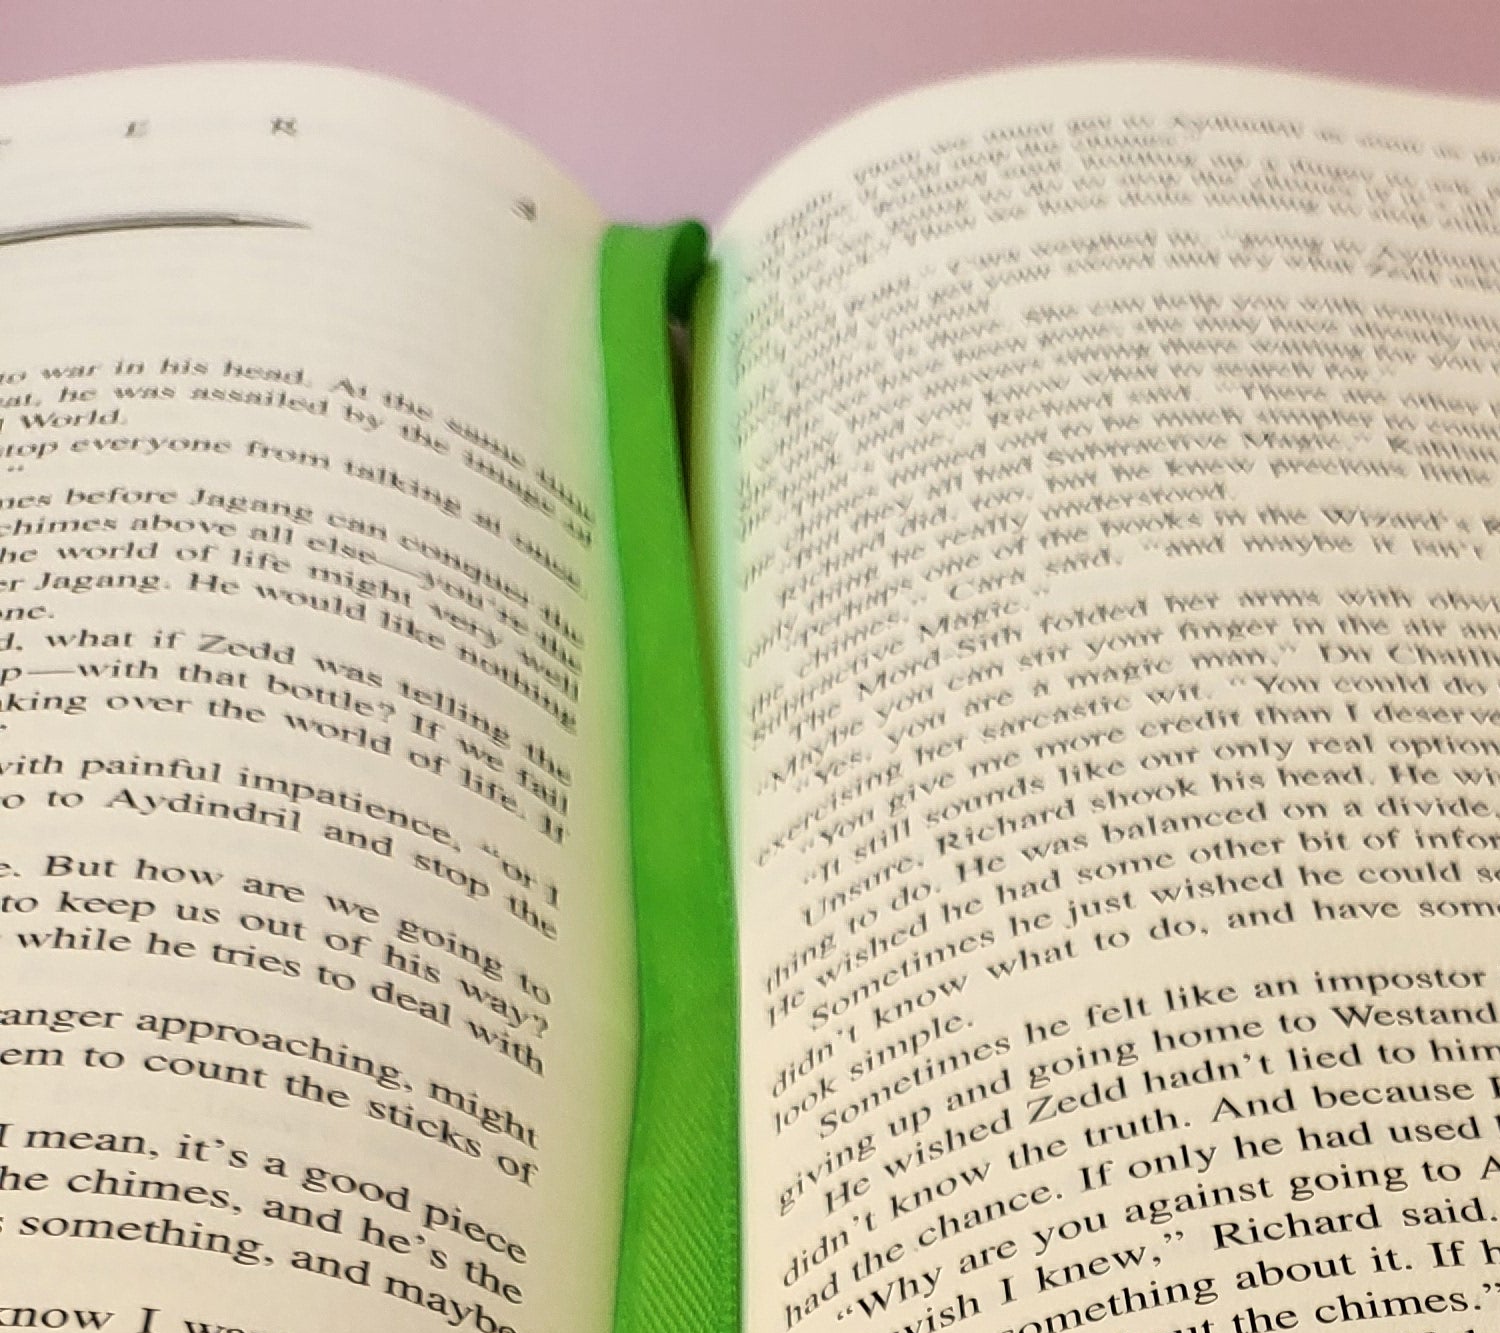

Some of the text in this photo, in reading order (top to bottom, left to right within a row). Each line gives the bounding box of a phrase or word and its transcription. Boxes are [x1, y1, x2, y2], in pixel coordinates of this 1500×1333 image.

[80, 755, 221, 783] painful
[239, 767, 461, 853] impatience,
[545, 880, 559, 910] I
[44, 855, 551, 1006] But how are we going to
[84, 1047, 125, 1069] to
[143, 1055, 268, 1089] count
[285, 1074, 350, 1109] the
[368, 1099, 481, 1158] sticks
[496, 1155, 539, 1188] of
[136, 1014, 413, 1093] approaching,
[429, 1079, 539, 1150] might
[780, 1133, 876, 1217] giving
[887, 1105, 931, 1137] up
[947, 1067, 1011, 1112] and
[1029, 1041, 1139, 1090] going
[1152, 1021, 1264, 1053] home
[1278, 1013, 1317, 1034] to
[24, 1130, 159, 1157] mean,
[263, 1156, 288, 1178] a
[301, 1167, 411, 1213] good
[422, 1203, 527, 1264] piece
[66, 1168, 242, 1213] chimes,
[262, 1200, 342, 1235] and
[464, 1261, 523, 1305] the
[960, 1239, 1017, 1275] are
[1032, 1212, 1108, 1257] you
[1125, 1176, 1273, 1225] against
[1290, 1163, 1409, 1202] going
[1421, 1161, 1461, 1183] to
